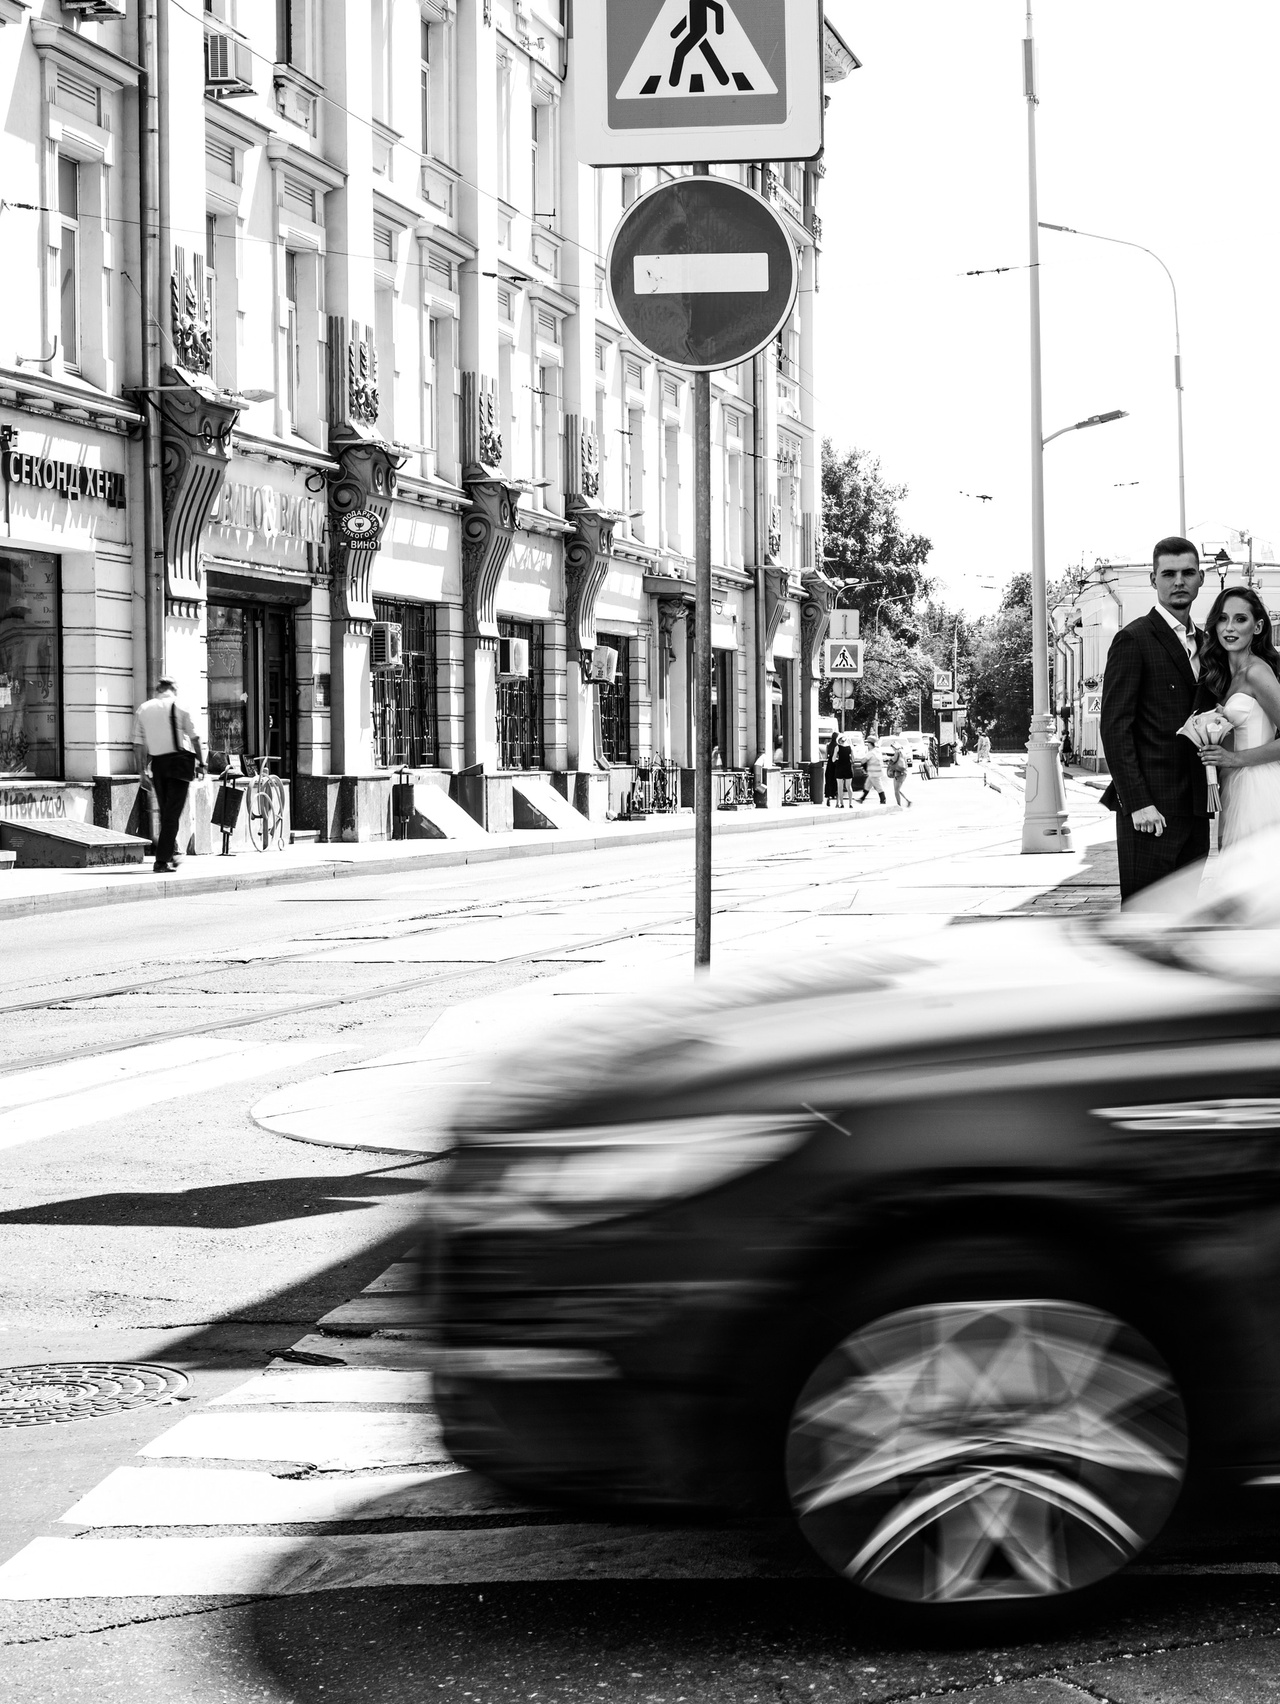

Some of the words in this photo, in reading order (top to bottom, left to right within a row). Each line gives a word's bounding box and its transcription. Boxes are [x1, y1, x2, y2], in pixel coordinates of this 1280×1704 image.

[10, 453, 80, 501] СЕКОНД
[86, 467, 126, 509] ХЕНД
[342, 510, 376, 523] ПОДАРКИ
[341, 526, 377, 539] АЛКОГОЛЬ
[350, 540, 376, 550] ВИНО
